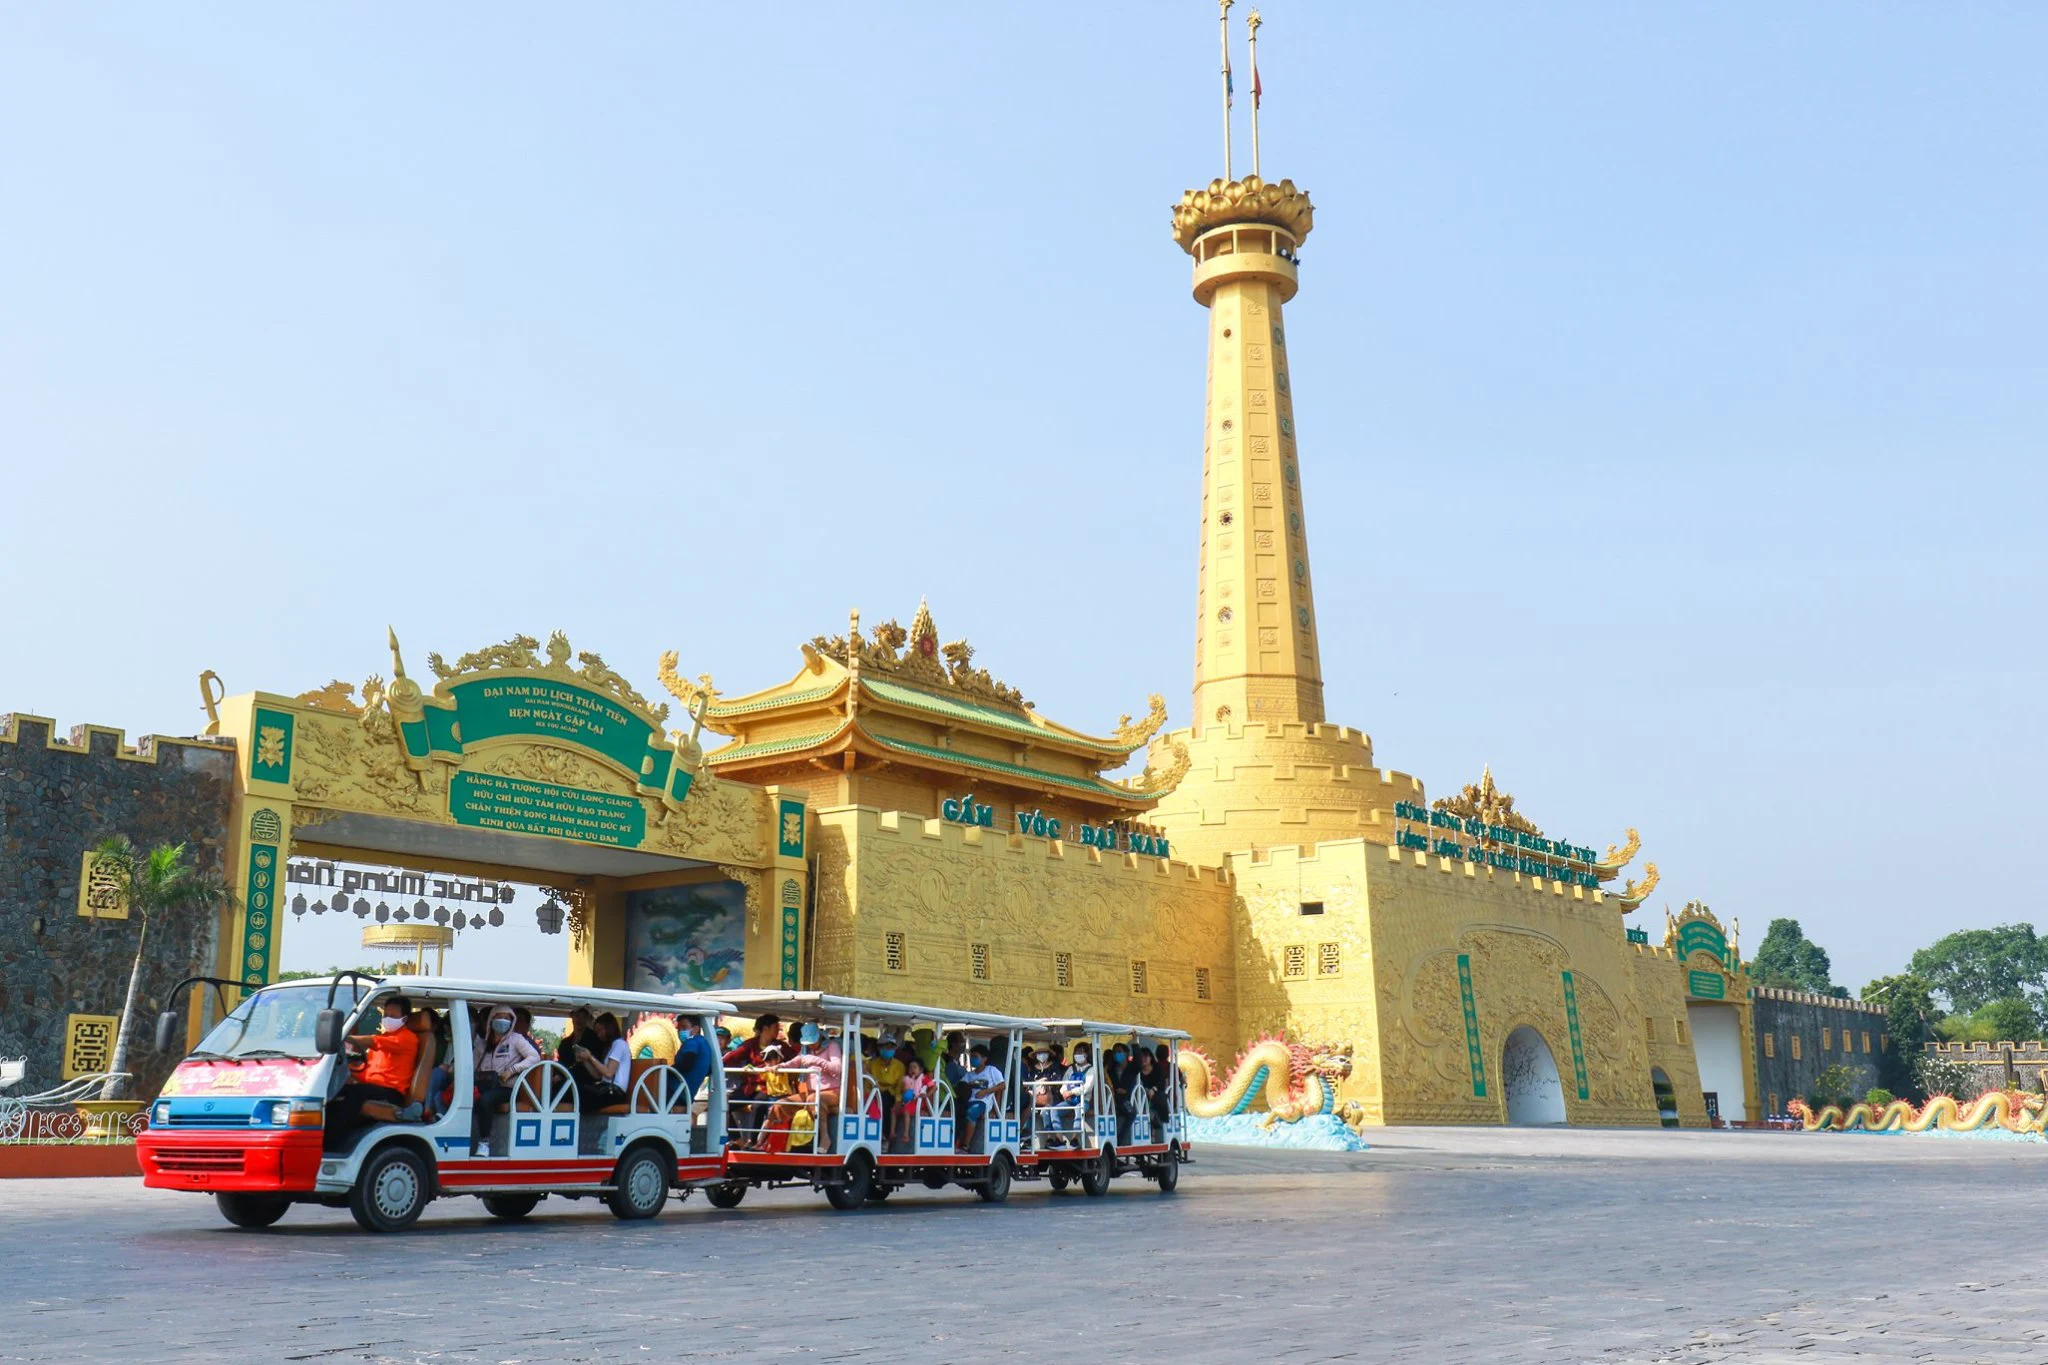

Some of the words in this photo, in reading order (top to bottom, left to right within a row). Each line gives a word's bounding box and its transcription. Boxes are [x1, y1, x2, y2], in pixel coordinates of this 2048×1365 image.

[483, 686, 504, 699] ĐẠI
[506, 686, 530, 696] NAM
[532, 687, 547, 697] DU
[550, 689, 574, 702] LỊCH
[509, 708, 531, 720] HẸN
[533, 709, 562, 721] NGÀY
[587, 721, 605, 736] LẠI
[560, 725, 579, 734] AGAIN
[581, 794, 605, 804] LONG
[606, 798, 633, 808] GIANG
[479, 817, 504, 828] KINH
[506, 821, 526, 831] QUA
[494, 805, 522, 817] THIỆN
[523, 810, 548, 820] SONG
[577, 818, 599, 828] KHAI
[941, 793, 994, 828] GẤM
[1016, 808, 1061, 839] VÓC
[1079, 823, 1115, 852] ĐẠI
[1127, 831, 1170, 859] NAM
